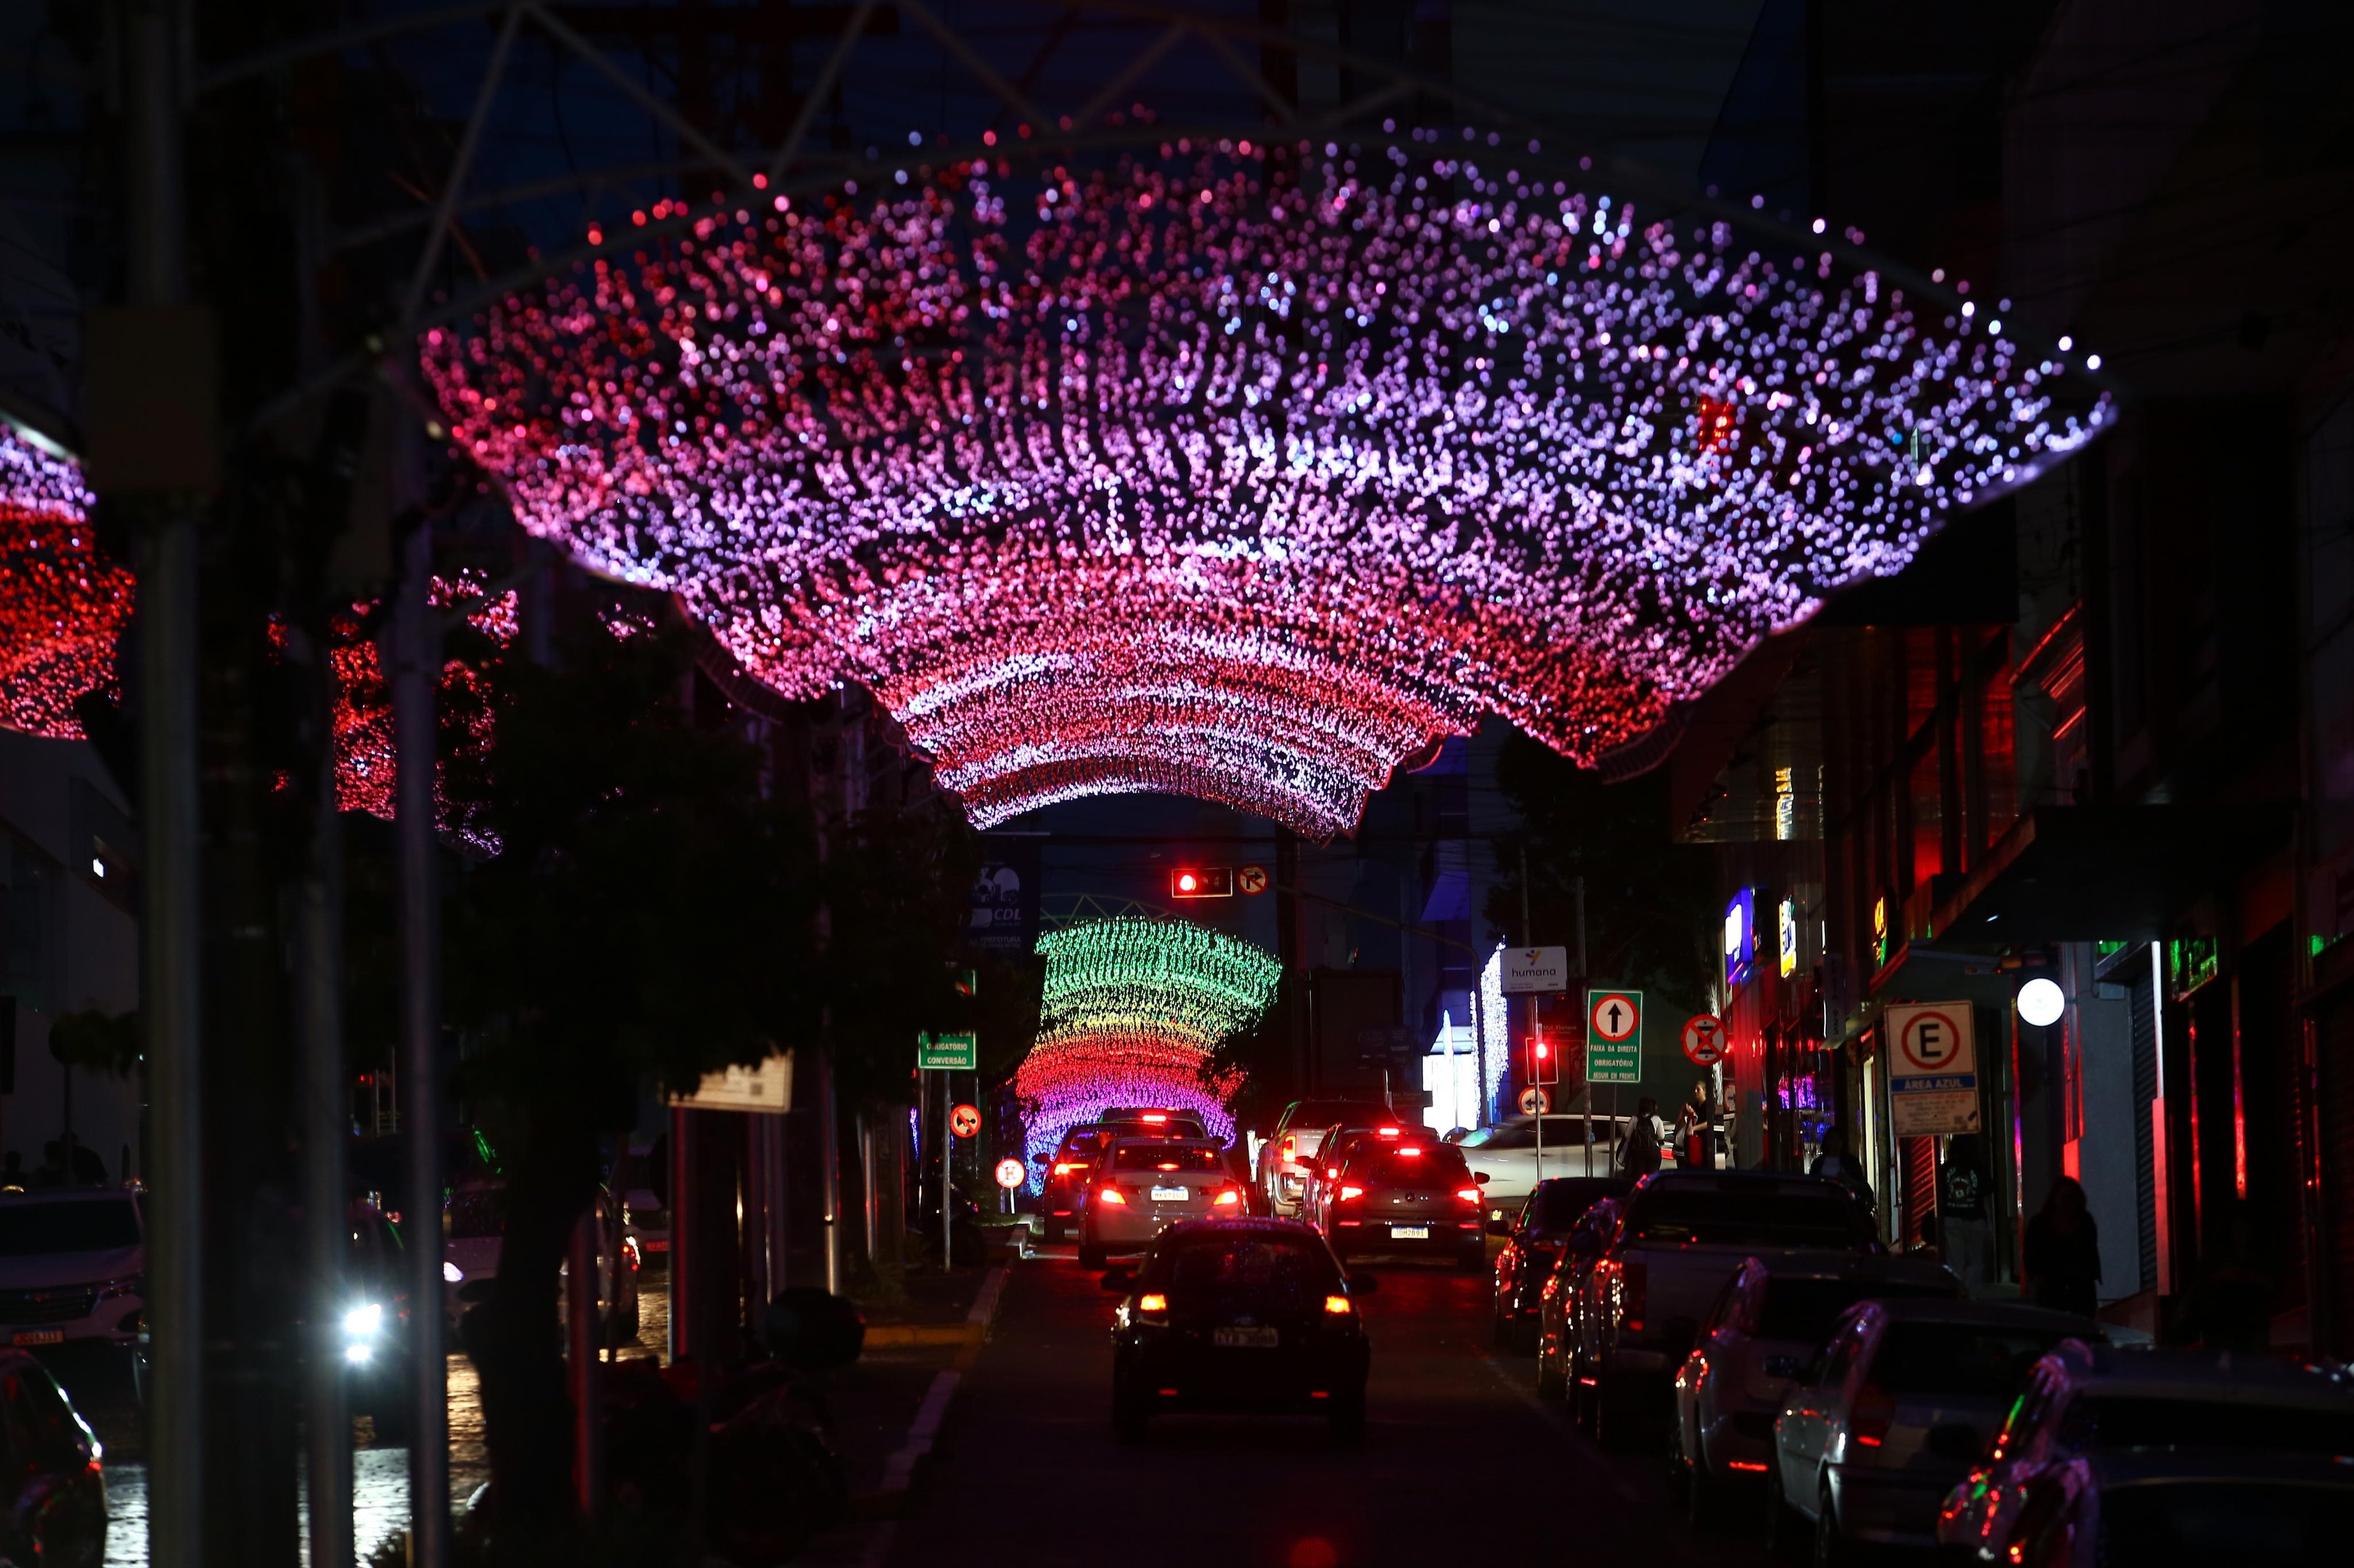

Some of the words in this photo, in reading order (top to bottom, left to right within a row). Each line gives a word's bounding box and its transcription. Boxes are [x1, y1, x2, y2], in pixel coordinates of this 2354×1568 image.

[994, 908, 1021, 920] CDL
[1512, 968, 1556, 977] humana
[1919, 1024, 1942, 1057] E
[1594, 1058, 1633, 1067] OBRIGATÓRIO
[1904, 1079, 1933, 1090] ÁREA
[1934, 1077, 1963, 1089] AZUL
